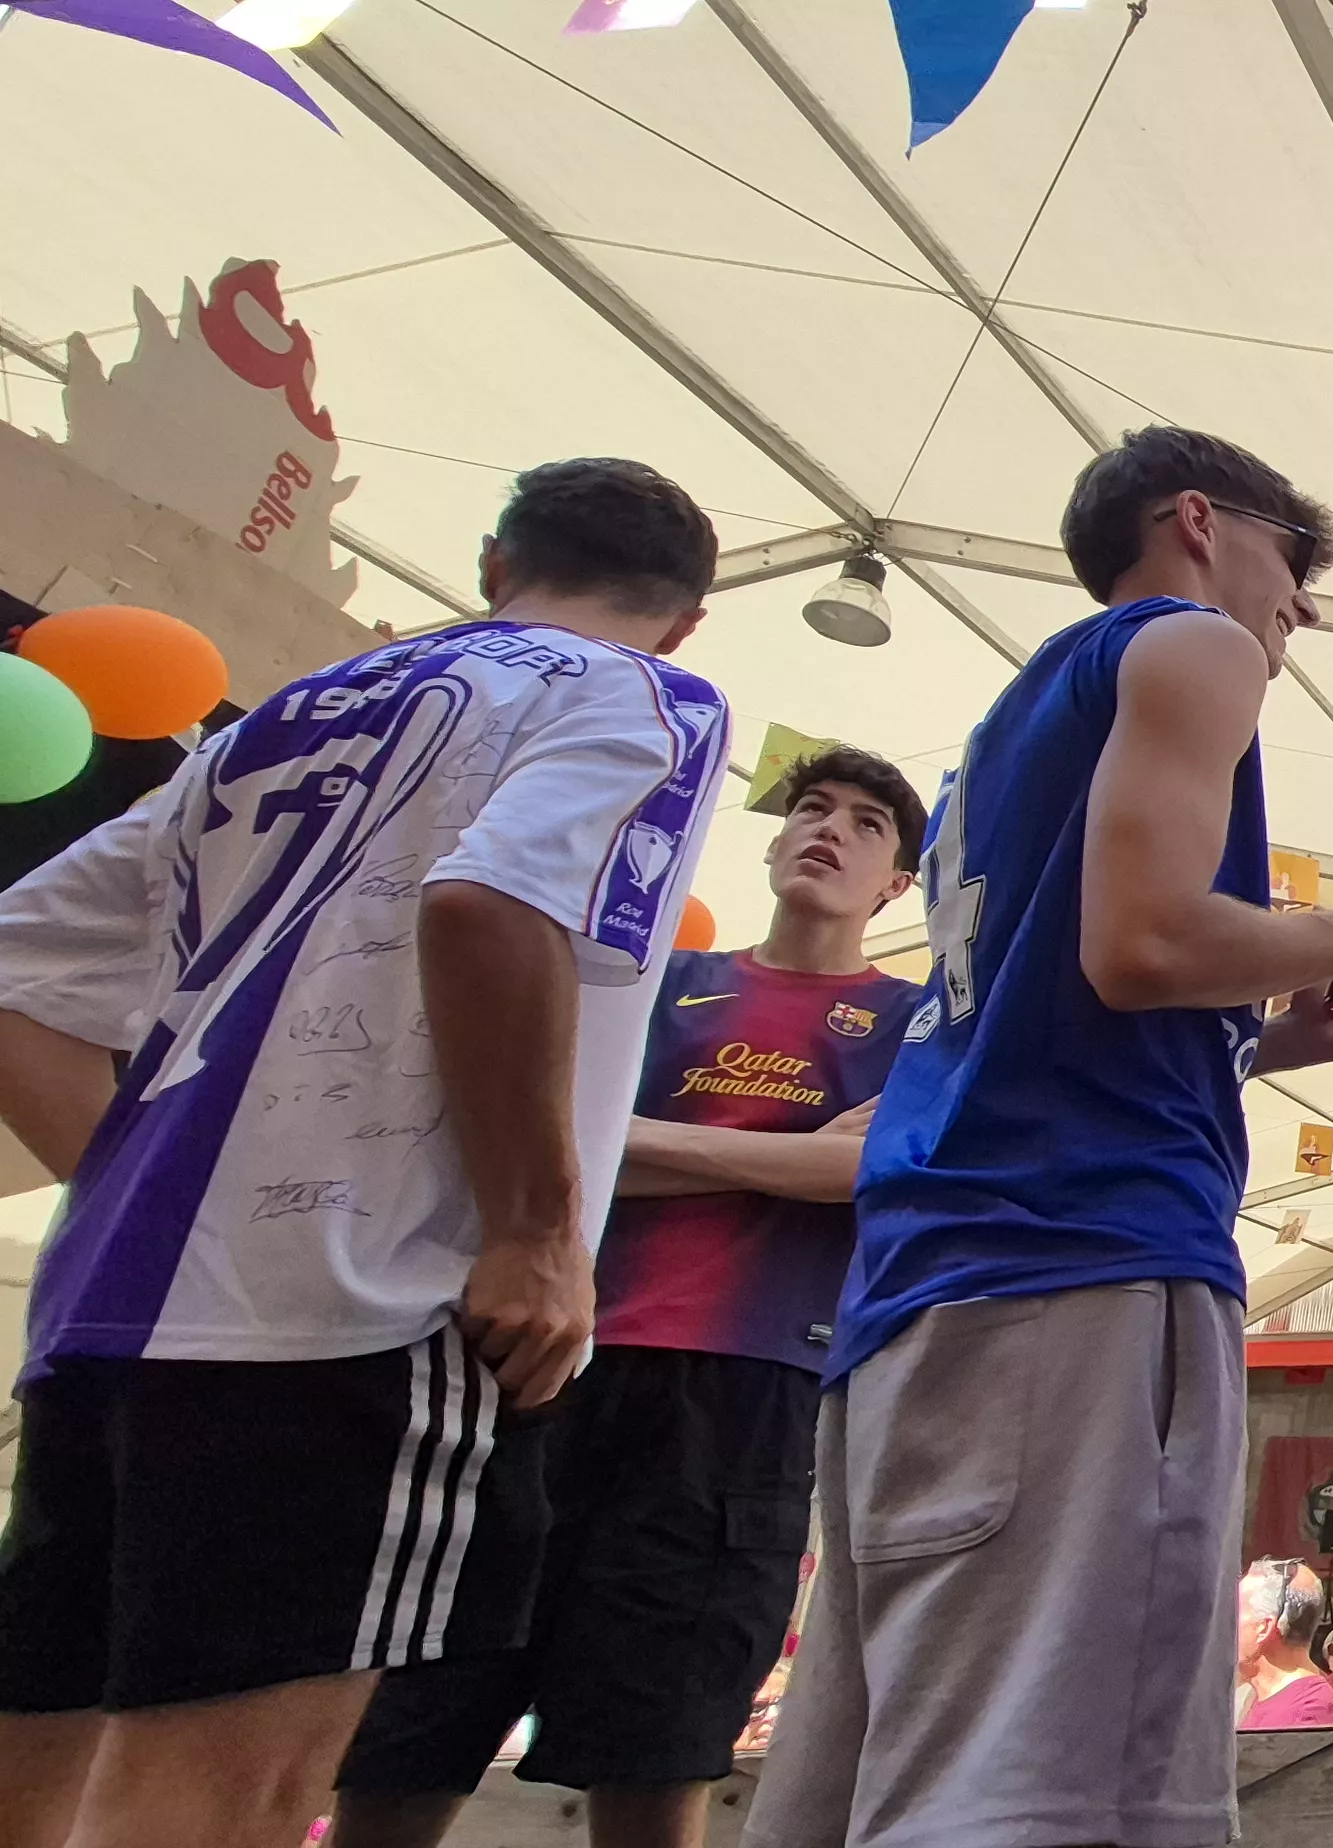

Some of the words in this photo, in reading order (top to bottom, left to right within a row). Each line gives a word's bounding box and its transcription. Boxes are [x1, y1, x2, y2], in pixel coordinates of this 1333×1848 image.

[279, 669, 413, 721] 198
[715, 1042, 813, 1077] Qatar
[670, 1067, 824, 1106] Foundation
